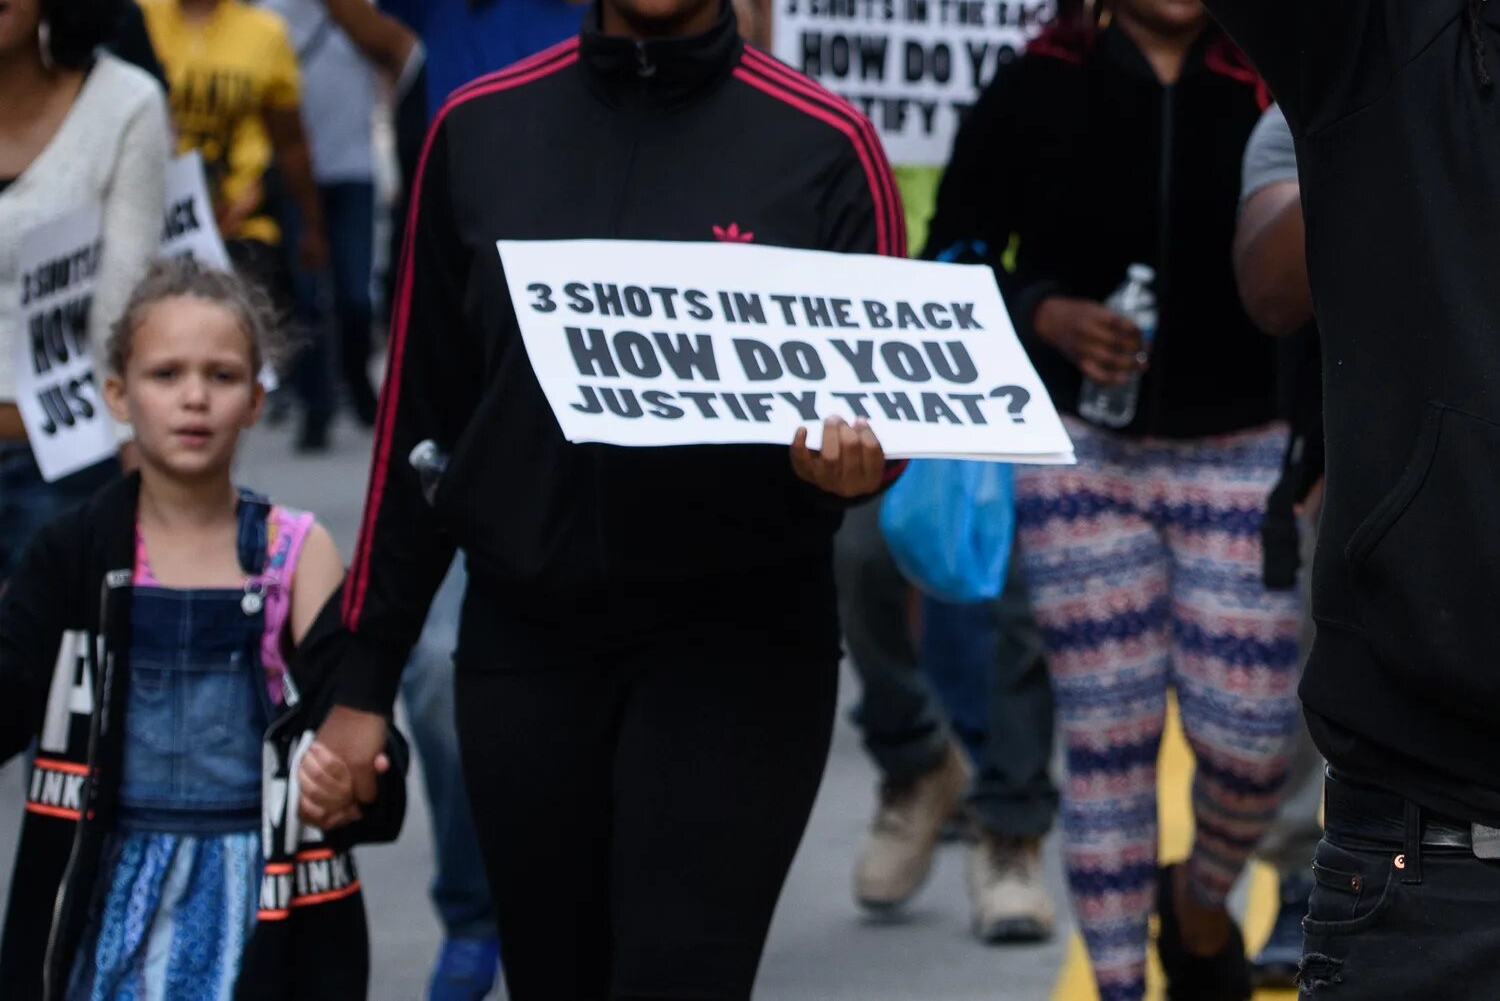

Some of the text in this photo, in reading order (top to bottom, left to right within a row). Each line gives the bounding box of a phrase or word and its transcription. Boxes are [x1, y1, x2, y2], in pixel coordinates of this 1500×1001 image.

[801, 30, 890, 81] HOW
[904, 40, 952, 84] DO
[527, 282, 985, 331] 3 SHOTS IN THE BACK
[563, 327, 980, 384] HOW DO YOU
[569, 384, 1032, 427] JUSTIFY THAT?
